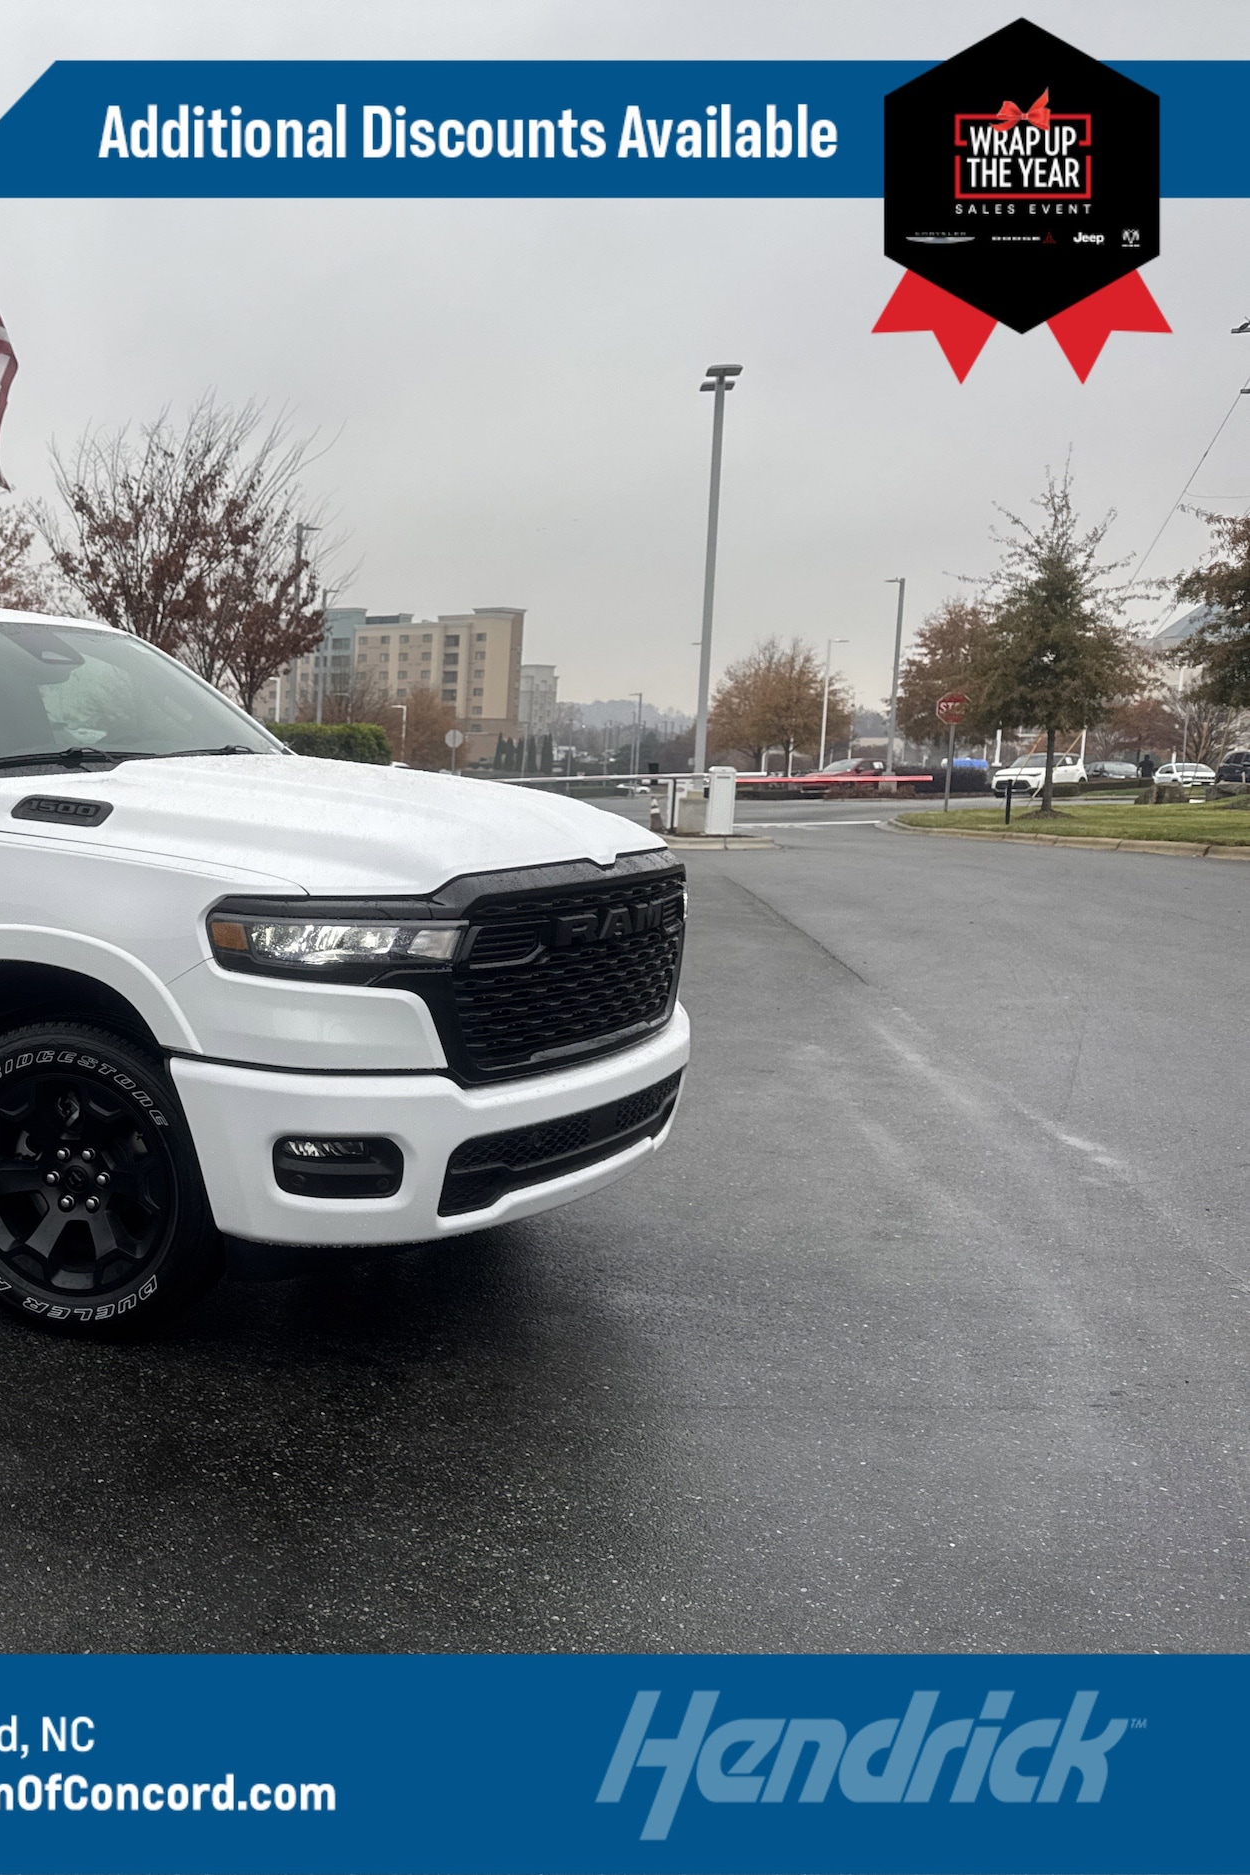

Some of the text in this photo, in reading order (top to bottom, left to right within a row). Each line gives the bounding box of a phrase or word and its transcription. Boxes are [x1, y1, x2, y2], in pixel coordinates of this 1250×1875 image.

[23, 799, 100, 817] 1500
[553, 900, 664, 947] RAM
[23, 1275, 158, 1321] DUELER
